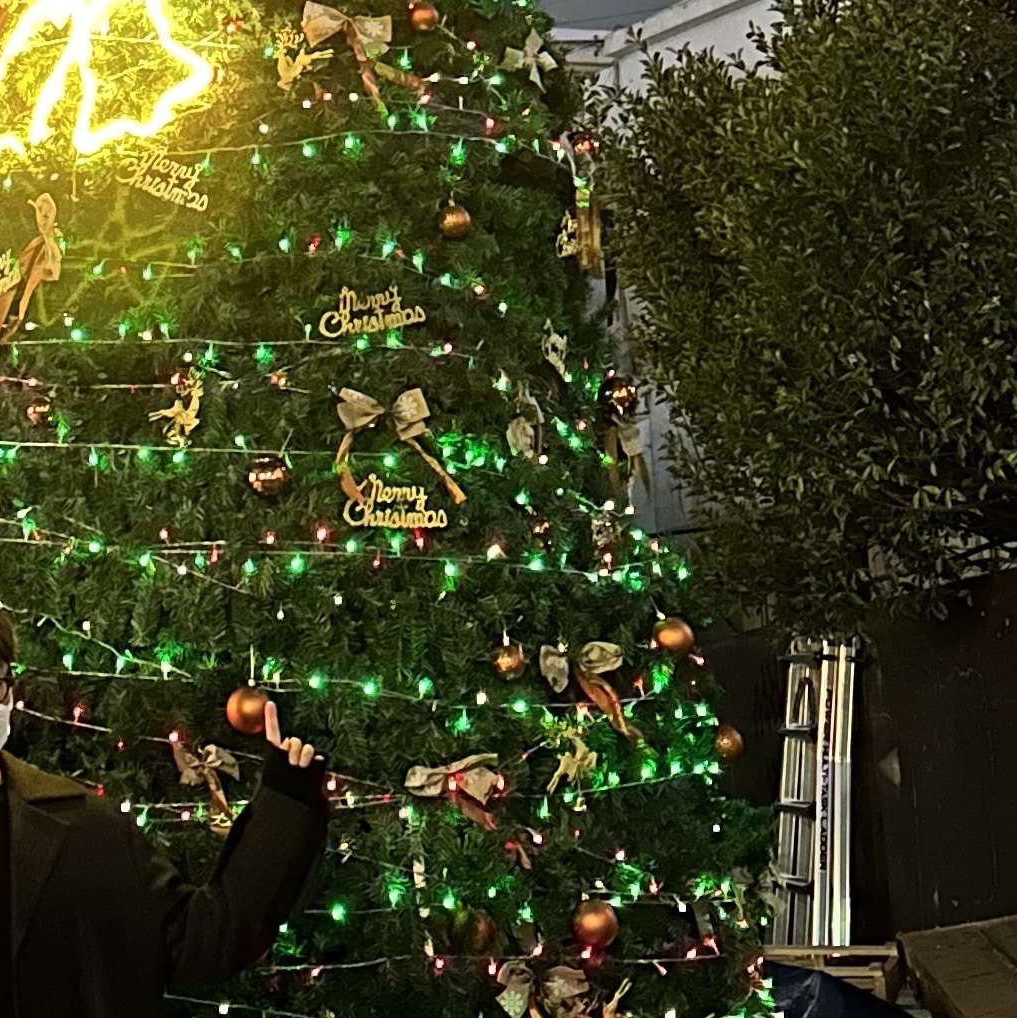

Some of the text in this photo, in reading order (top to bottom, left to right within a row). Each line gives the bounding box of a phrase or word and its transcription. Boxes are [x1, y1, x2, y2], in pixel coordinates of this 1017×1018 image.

[116, 158, 208, 211] Christmas
[139, 144, 203, 190] Merry
[339, 285, 402, 313] Merry
[319, 305, 426, 338] Christmas
[356, 473, 428, 511] Merry
[343, 499, 447, 529] Christmas
